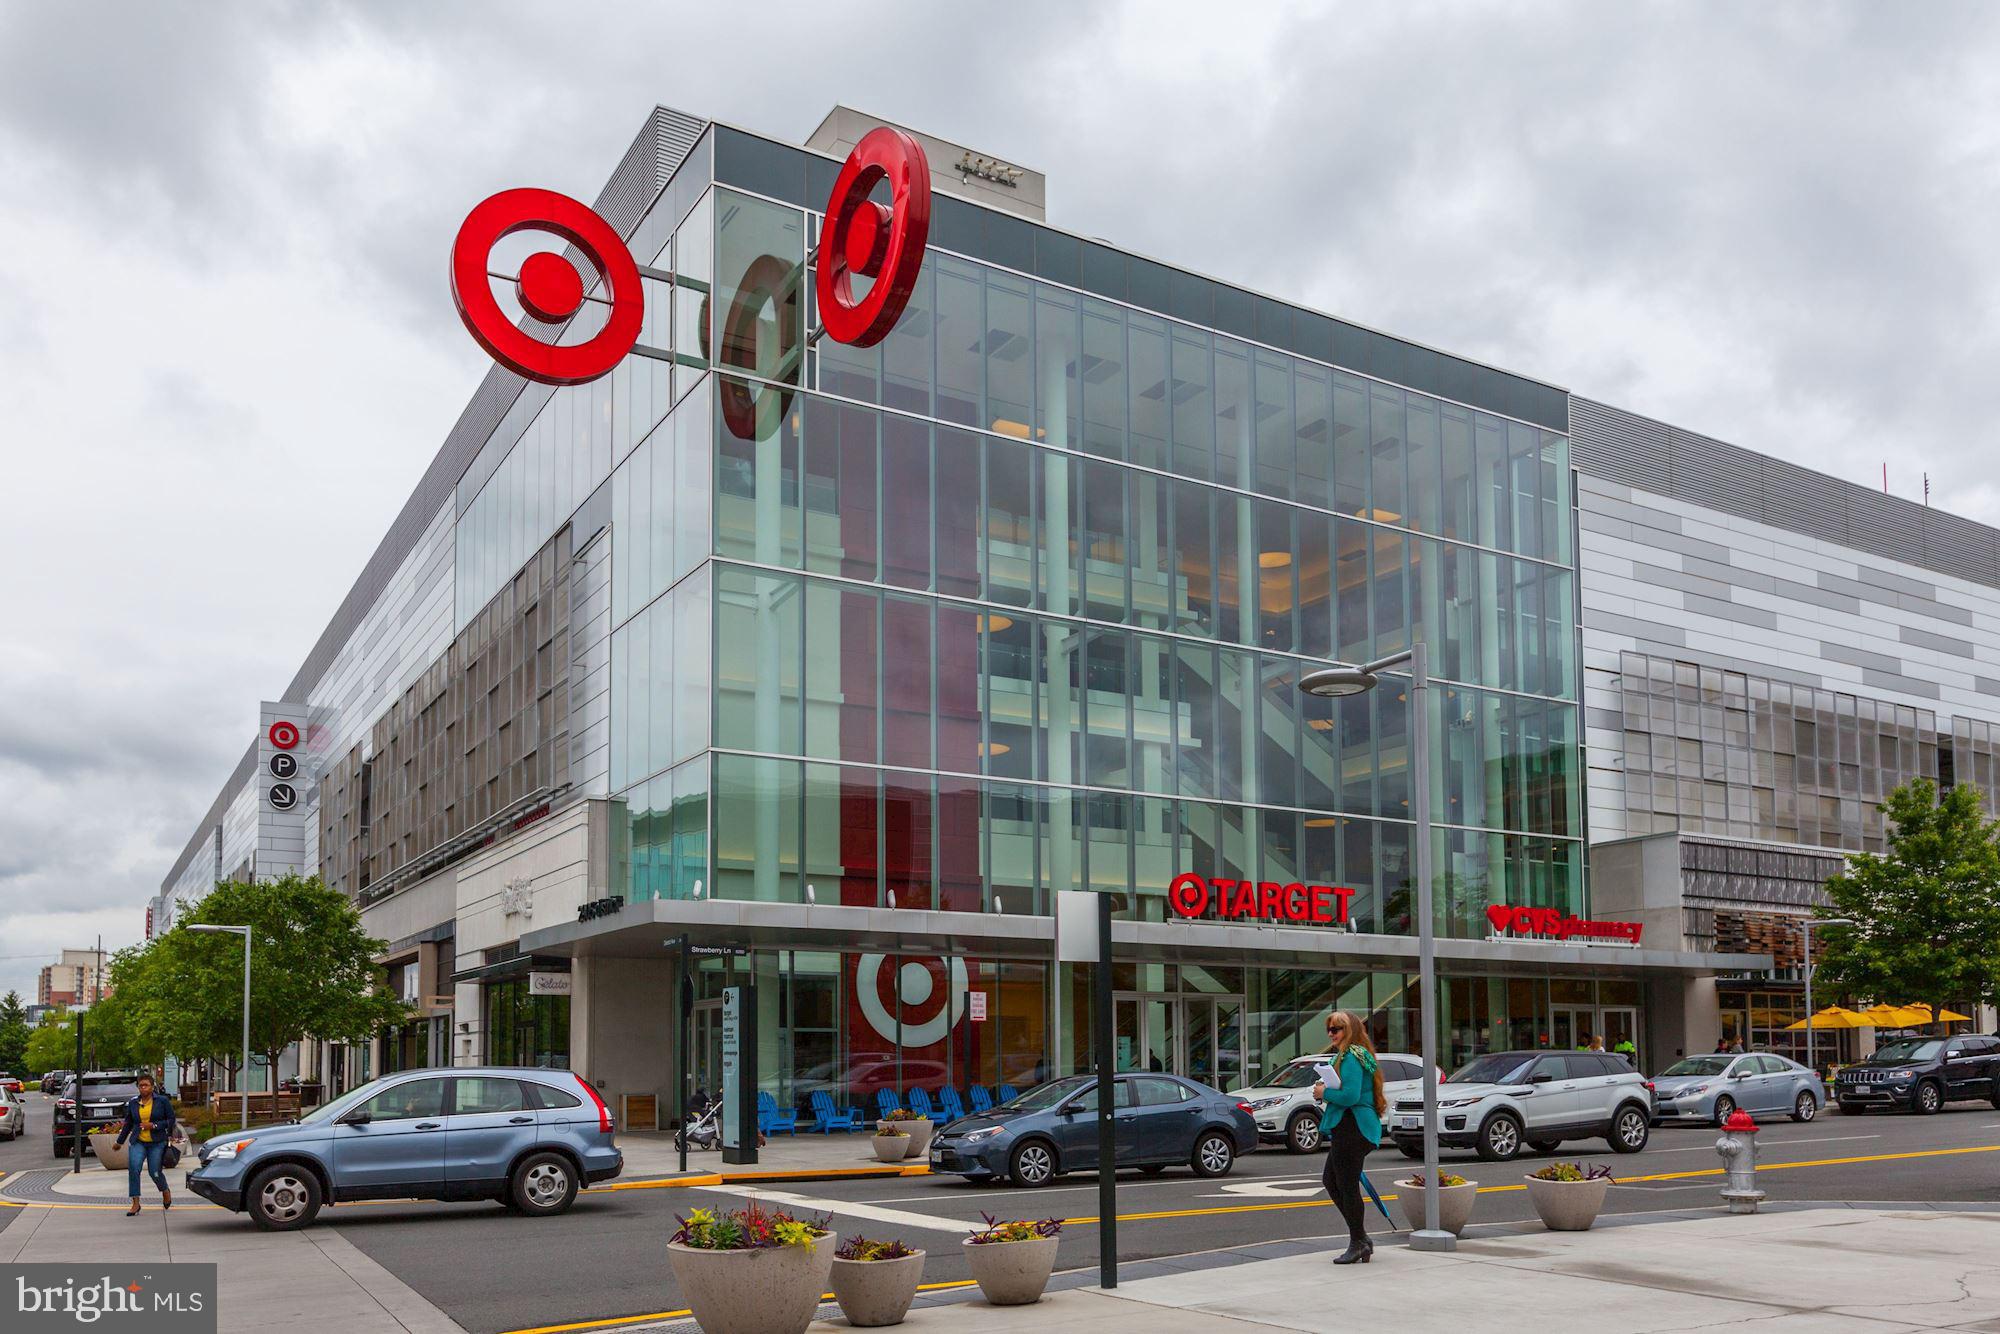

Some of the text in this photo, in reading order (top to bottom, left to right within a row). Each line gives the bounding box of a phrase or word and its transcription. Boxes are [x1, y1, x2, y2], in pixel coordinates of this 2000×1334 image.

[278, 758, 291, 773] P
[1208, 878, 1355, 923] TARGET
[1512, 906, 1643, 944] CVS pharmacy
[691, 946, 723, 954] Strawberry
[535, 977, 568, 989] Gelato
